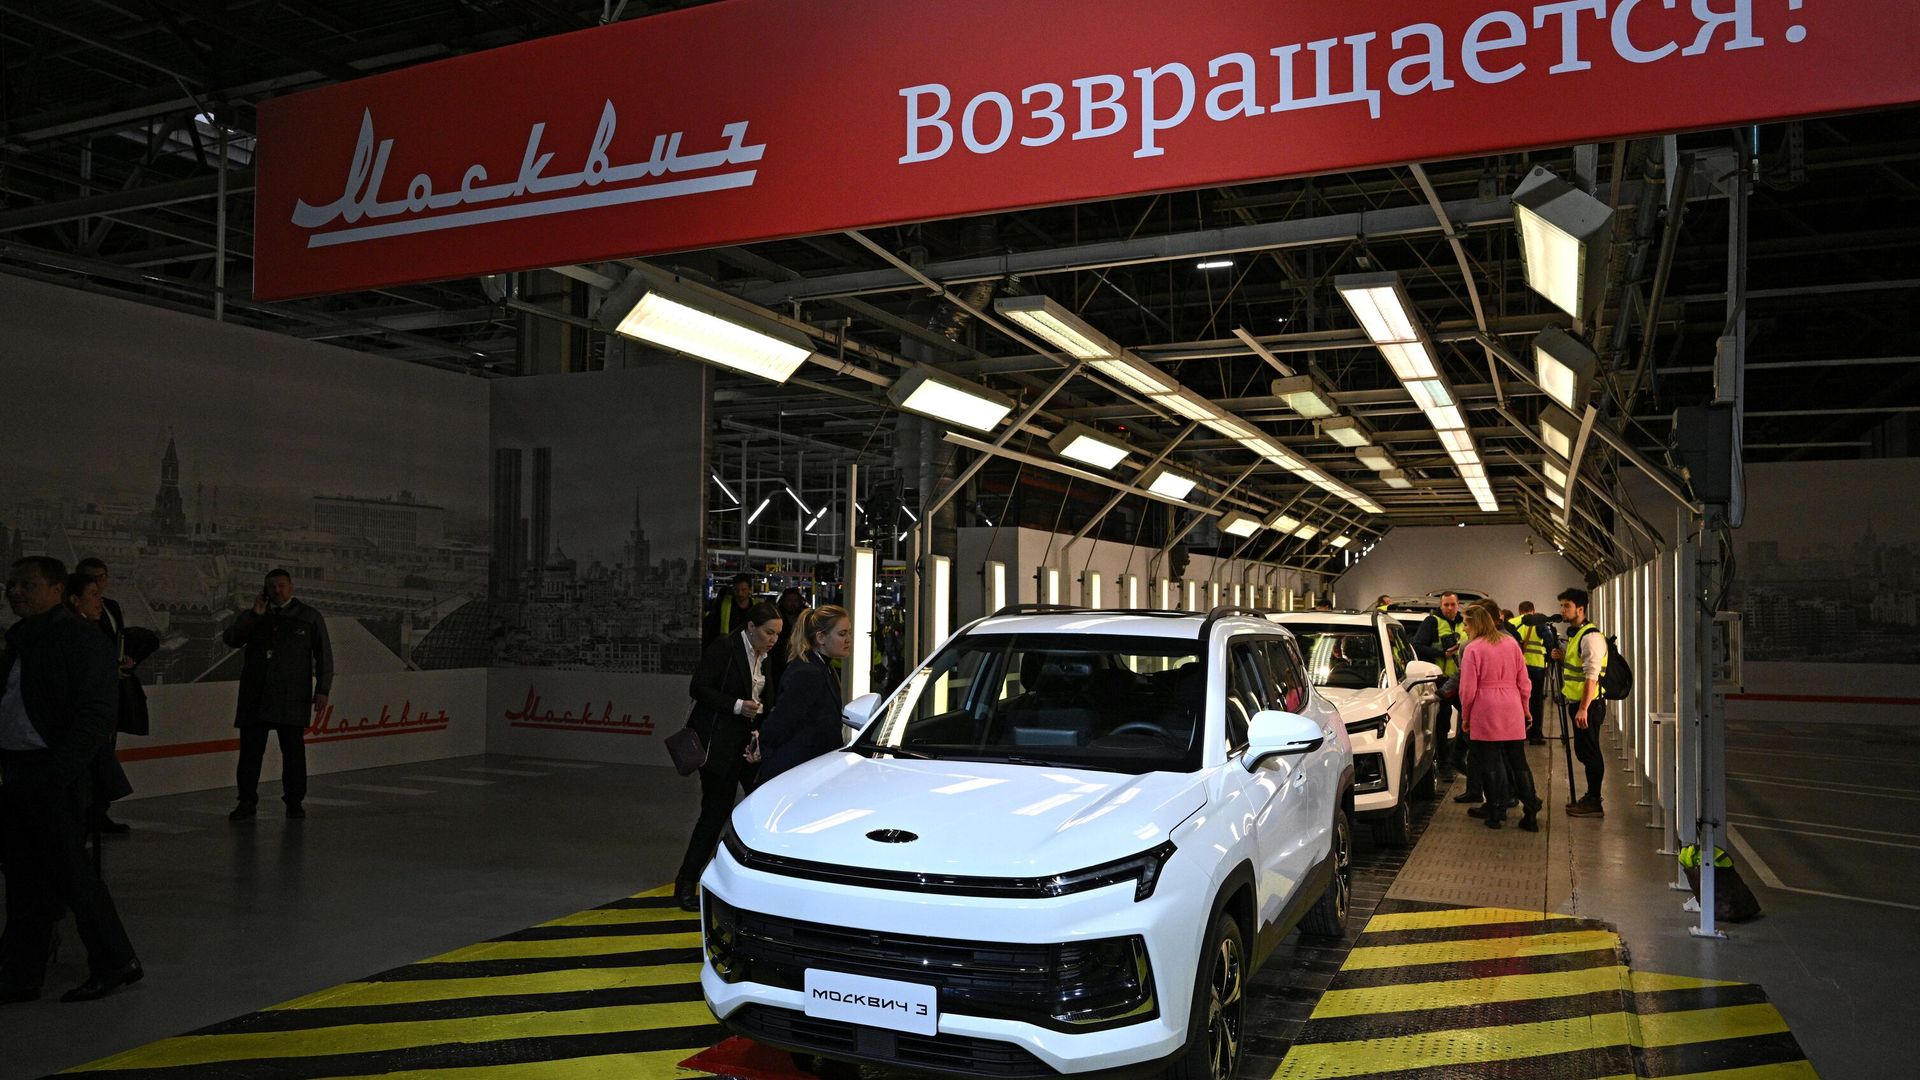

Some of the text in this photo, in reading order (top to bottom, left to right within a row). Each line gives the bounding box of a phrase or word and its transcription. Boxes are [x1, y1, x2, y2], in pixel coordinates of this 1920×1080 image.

[291, 99, 767, 229] Москвич
[505, 684, 655, 730] Москвич
[812, 988, 928, 1016] МОСКВИЧ 3
